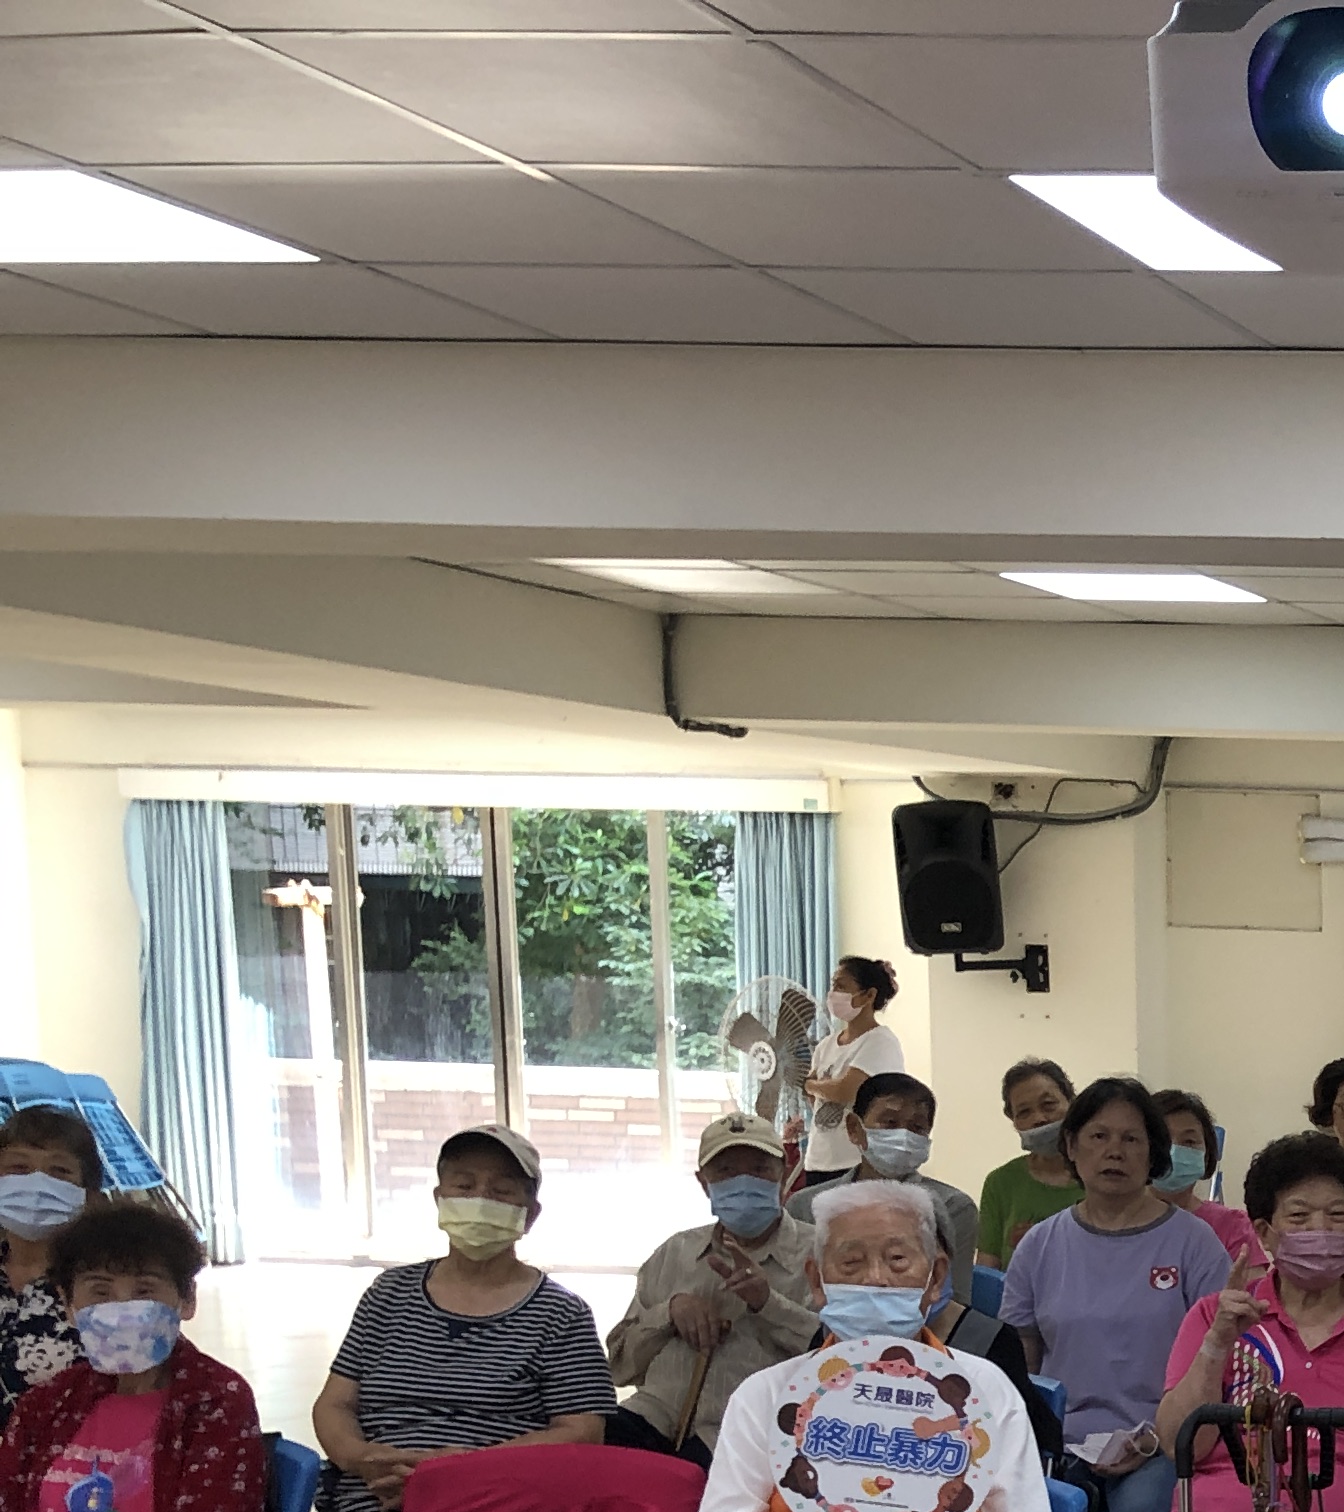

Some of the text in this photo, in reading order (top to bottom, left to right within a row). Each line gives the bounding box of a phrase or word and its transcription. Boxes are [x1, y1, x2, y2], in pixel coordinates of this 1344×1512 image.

[853, 1383, 936, 1410] 天晟醫院
[804, 1417, 969, 1474] 終止暴力
